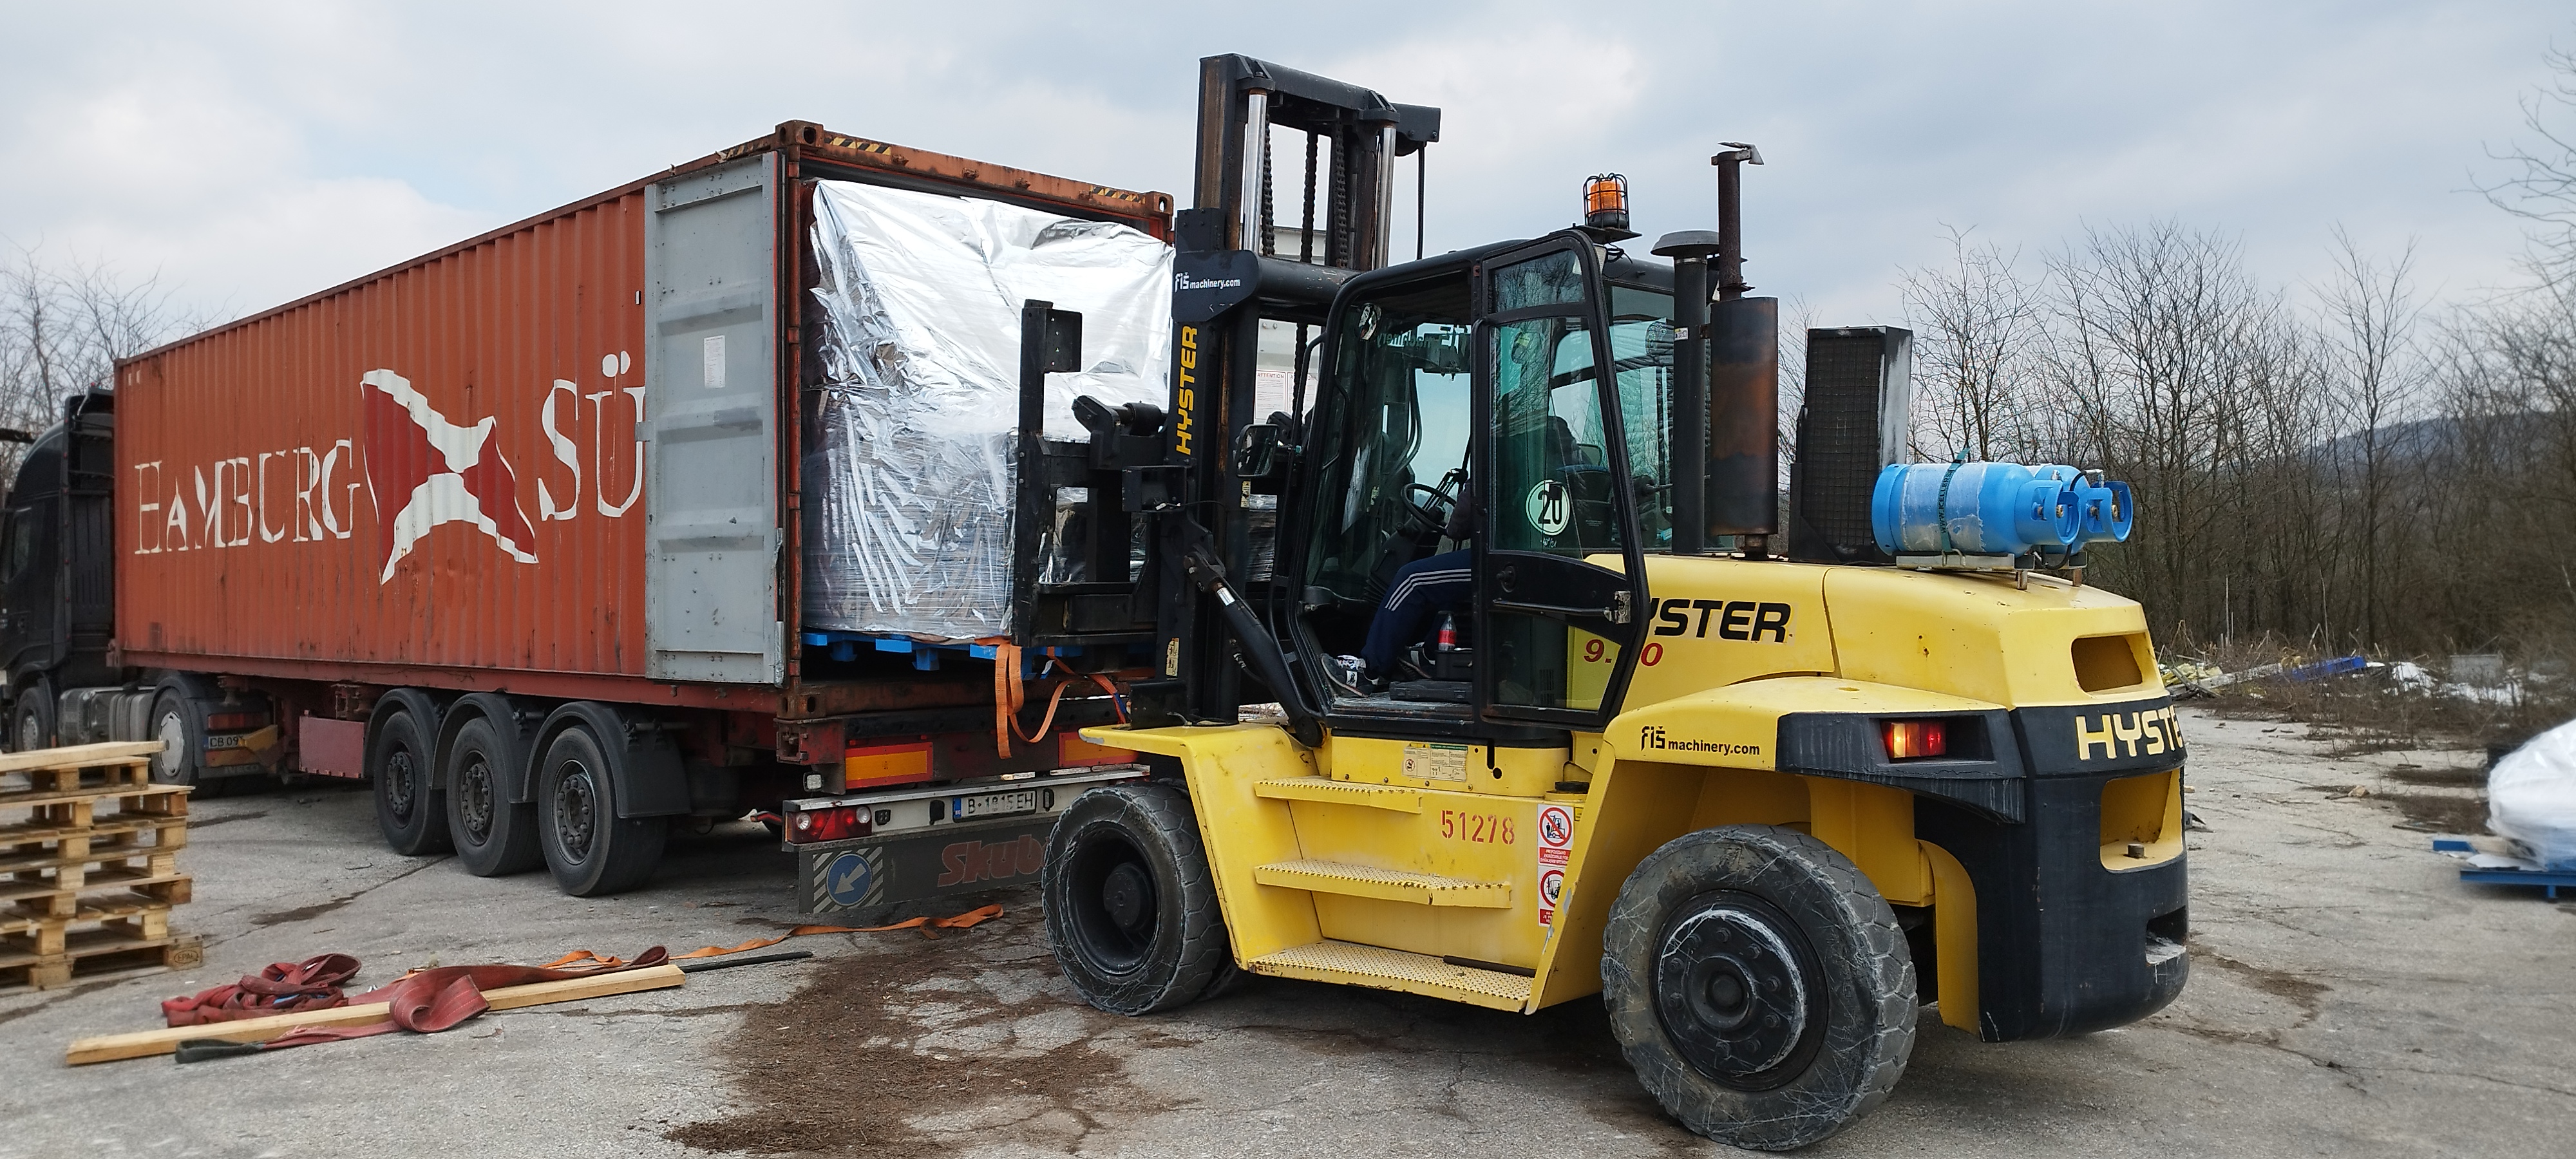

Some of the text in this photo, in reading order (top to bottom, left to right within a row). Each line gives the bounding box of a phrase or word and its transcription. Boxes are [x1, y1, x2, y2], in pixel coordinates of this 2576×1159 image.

[1175, 325, 1197, 455] HYSTER
[134, 437, 361, 555] HAMBURG
[1538, 490, 1562, 525] 20
[1584, 639, 1663, 666] 9.0
[1668, 739, 1760, 756] machinery.com
[1441, 809, 1515, 845] 51278
